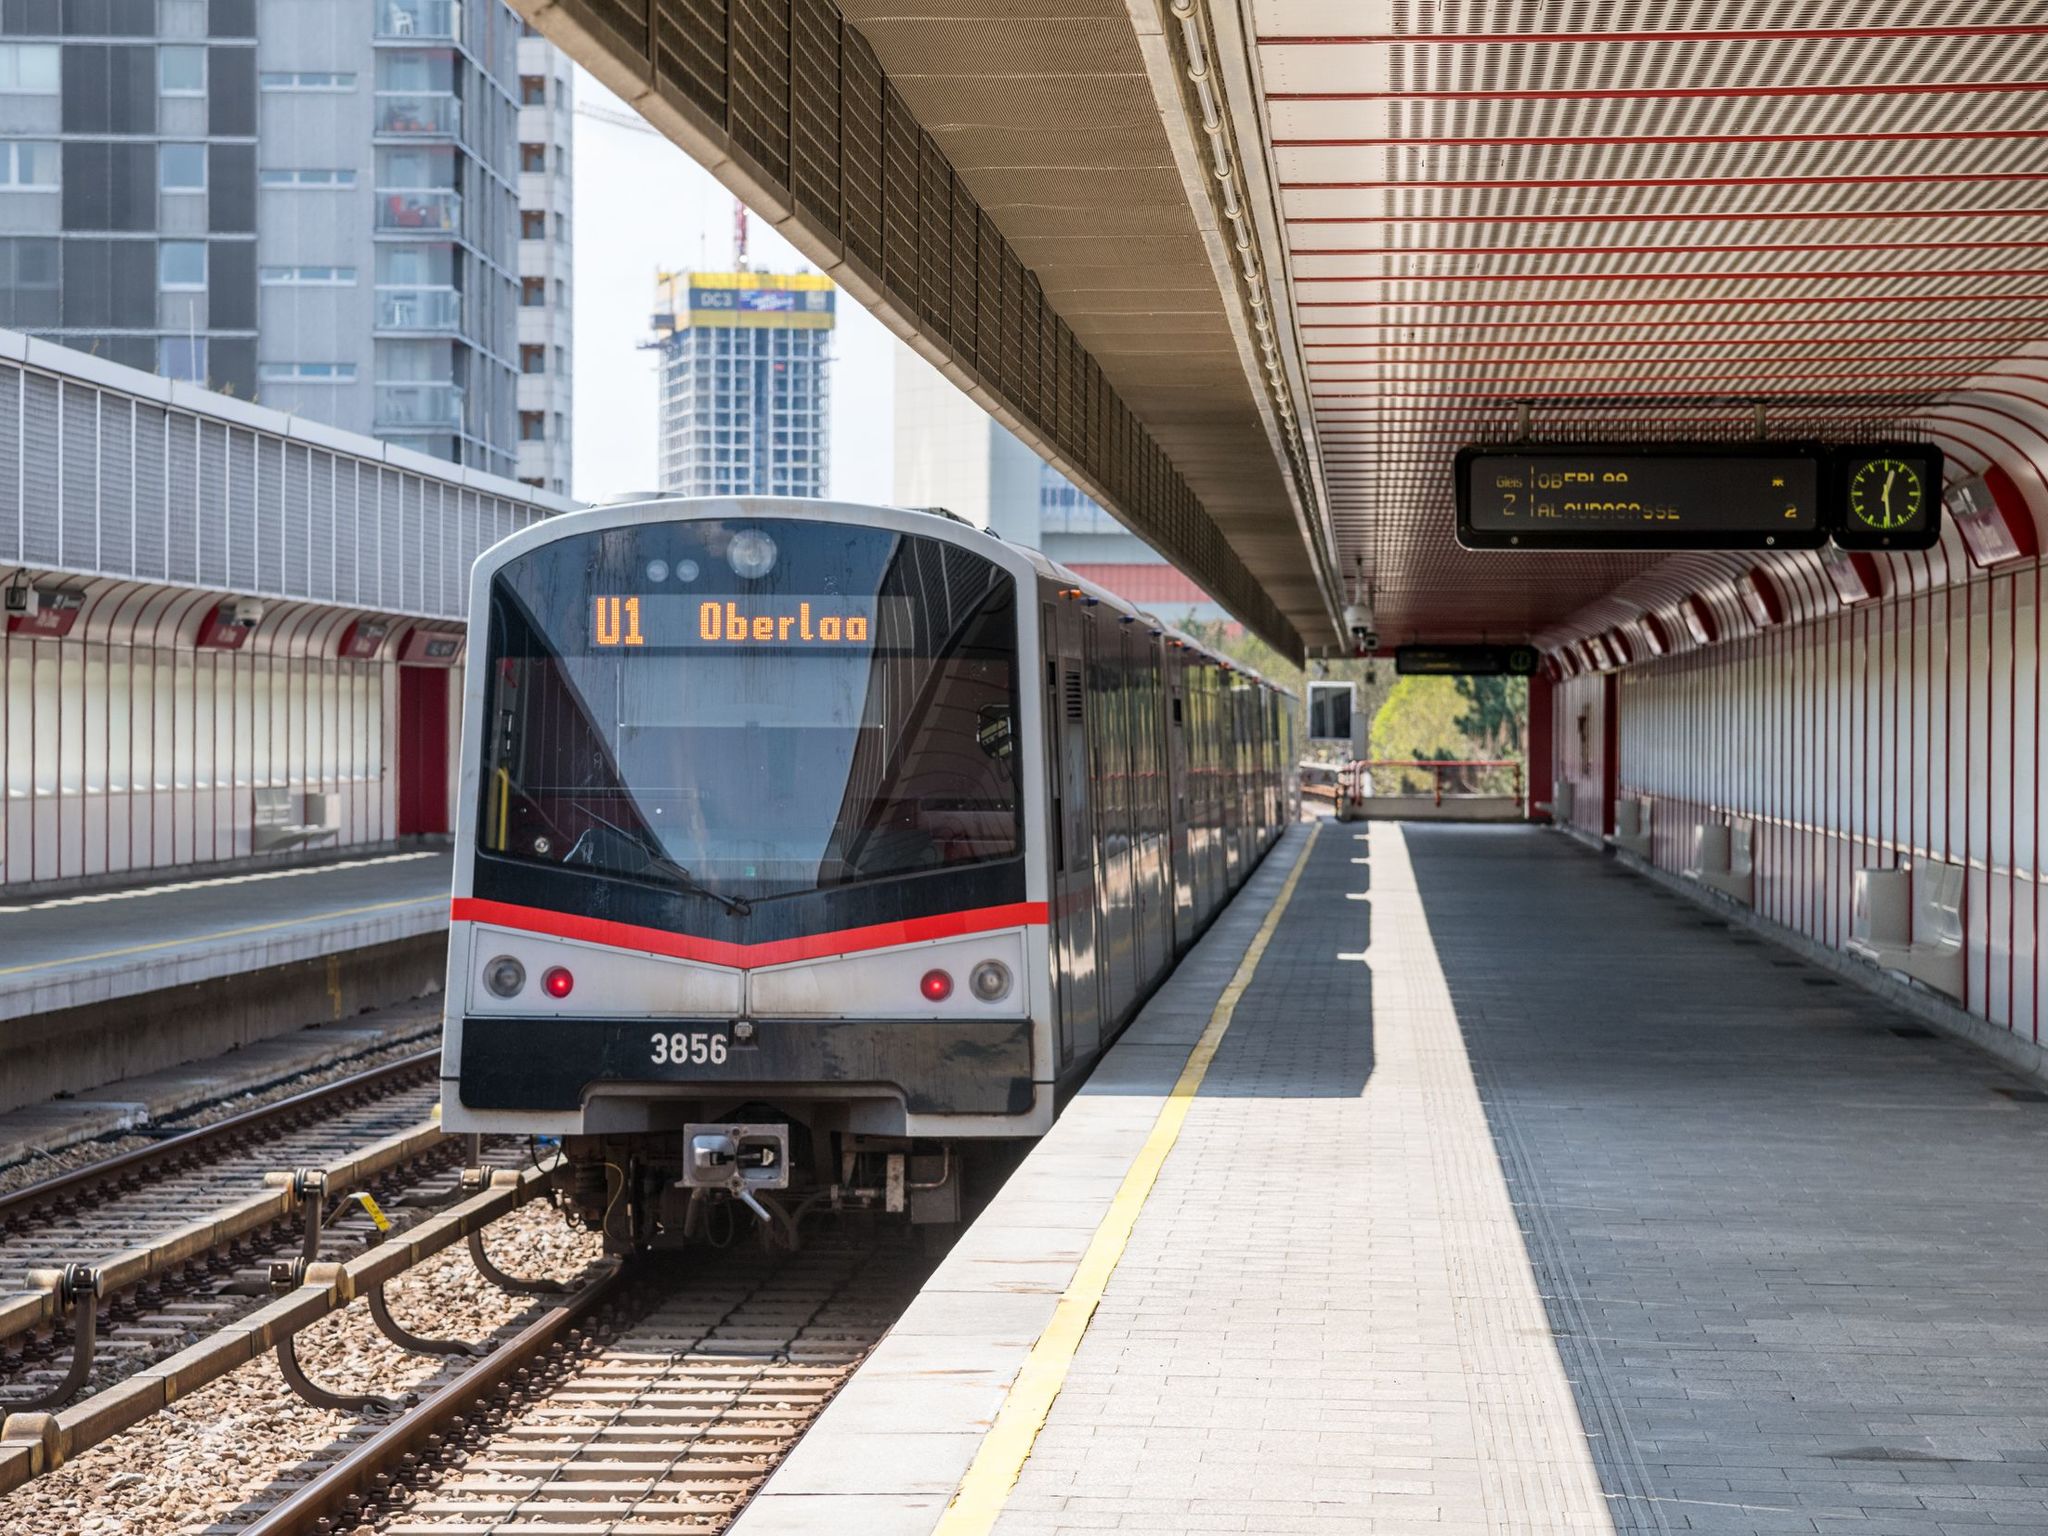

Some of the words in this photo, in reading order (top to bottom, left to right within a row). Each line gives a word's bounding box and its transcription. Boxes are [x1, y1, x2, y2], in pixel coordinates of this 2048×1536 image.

[701, 292, 732, 307] DC3
[596, 597, 644, 644] U1
[699, 602, 867, 640] Oberlaa
[650, 1032, 728, 1064] 3856
